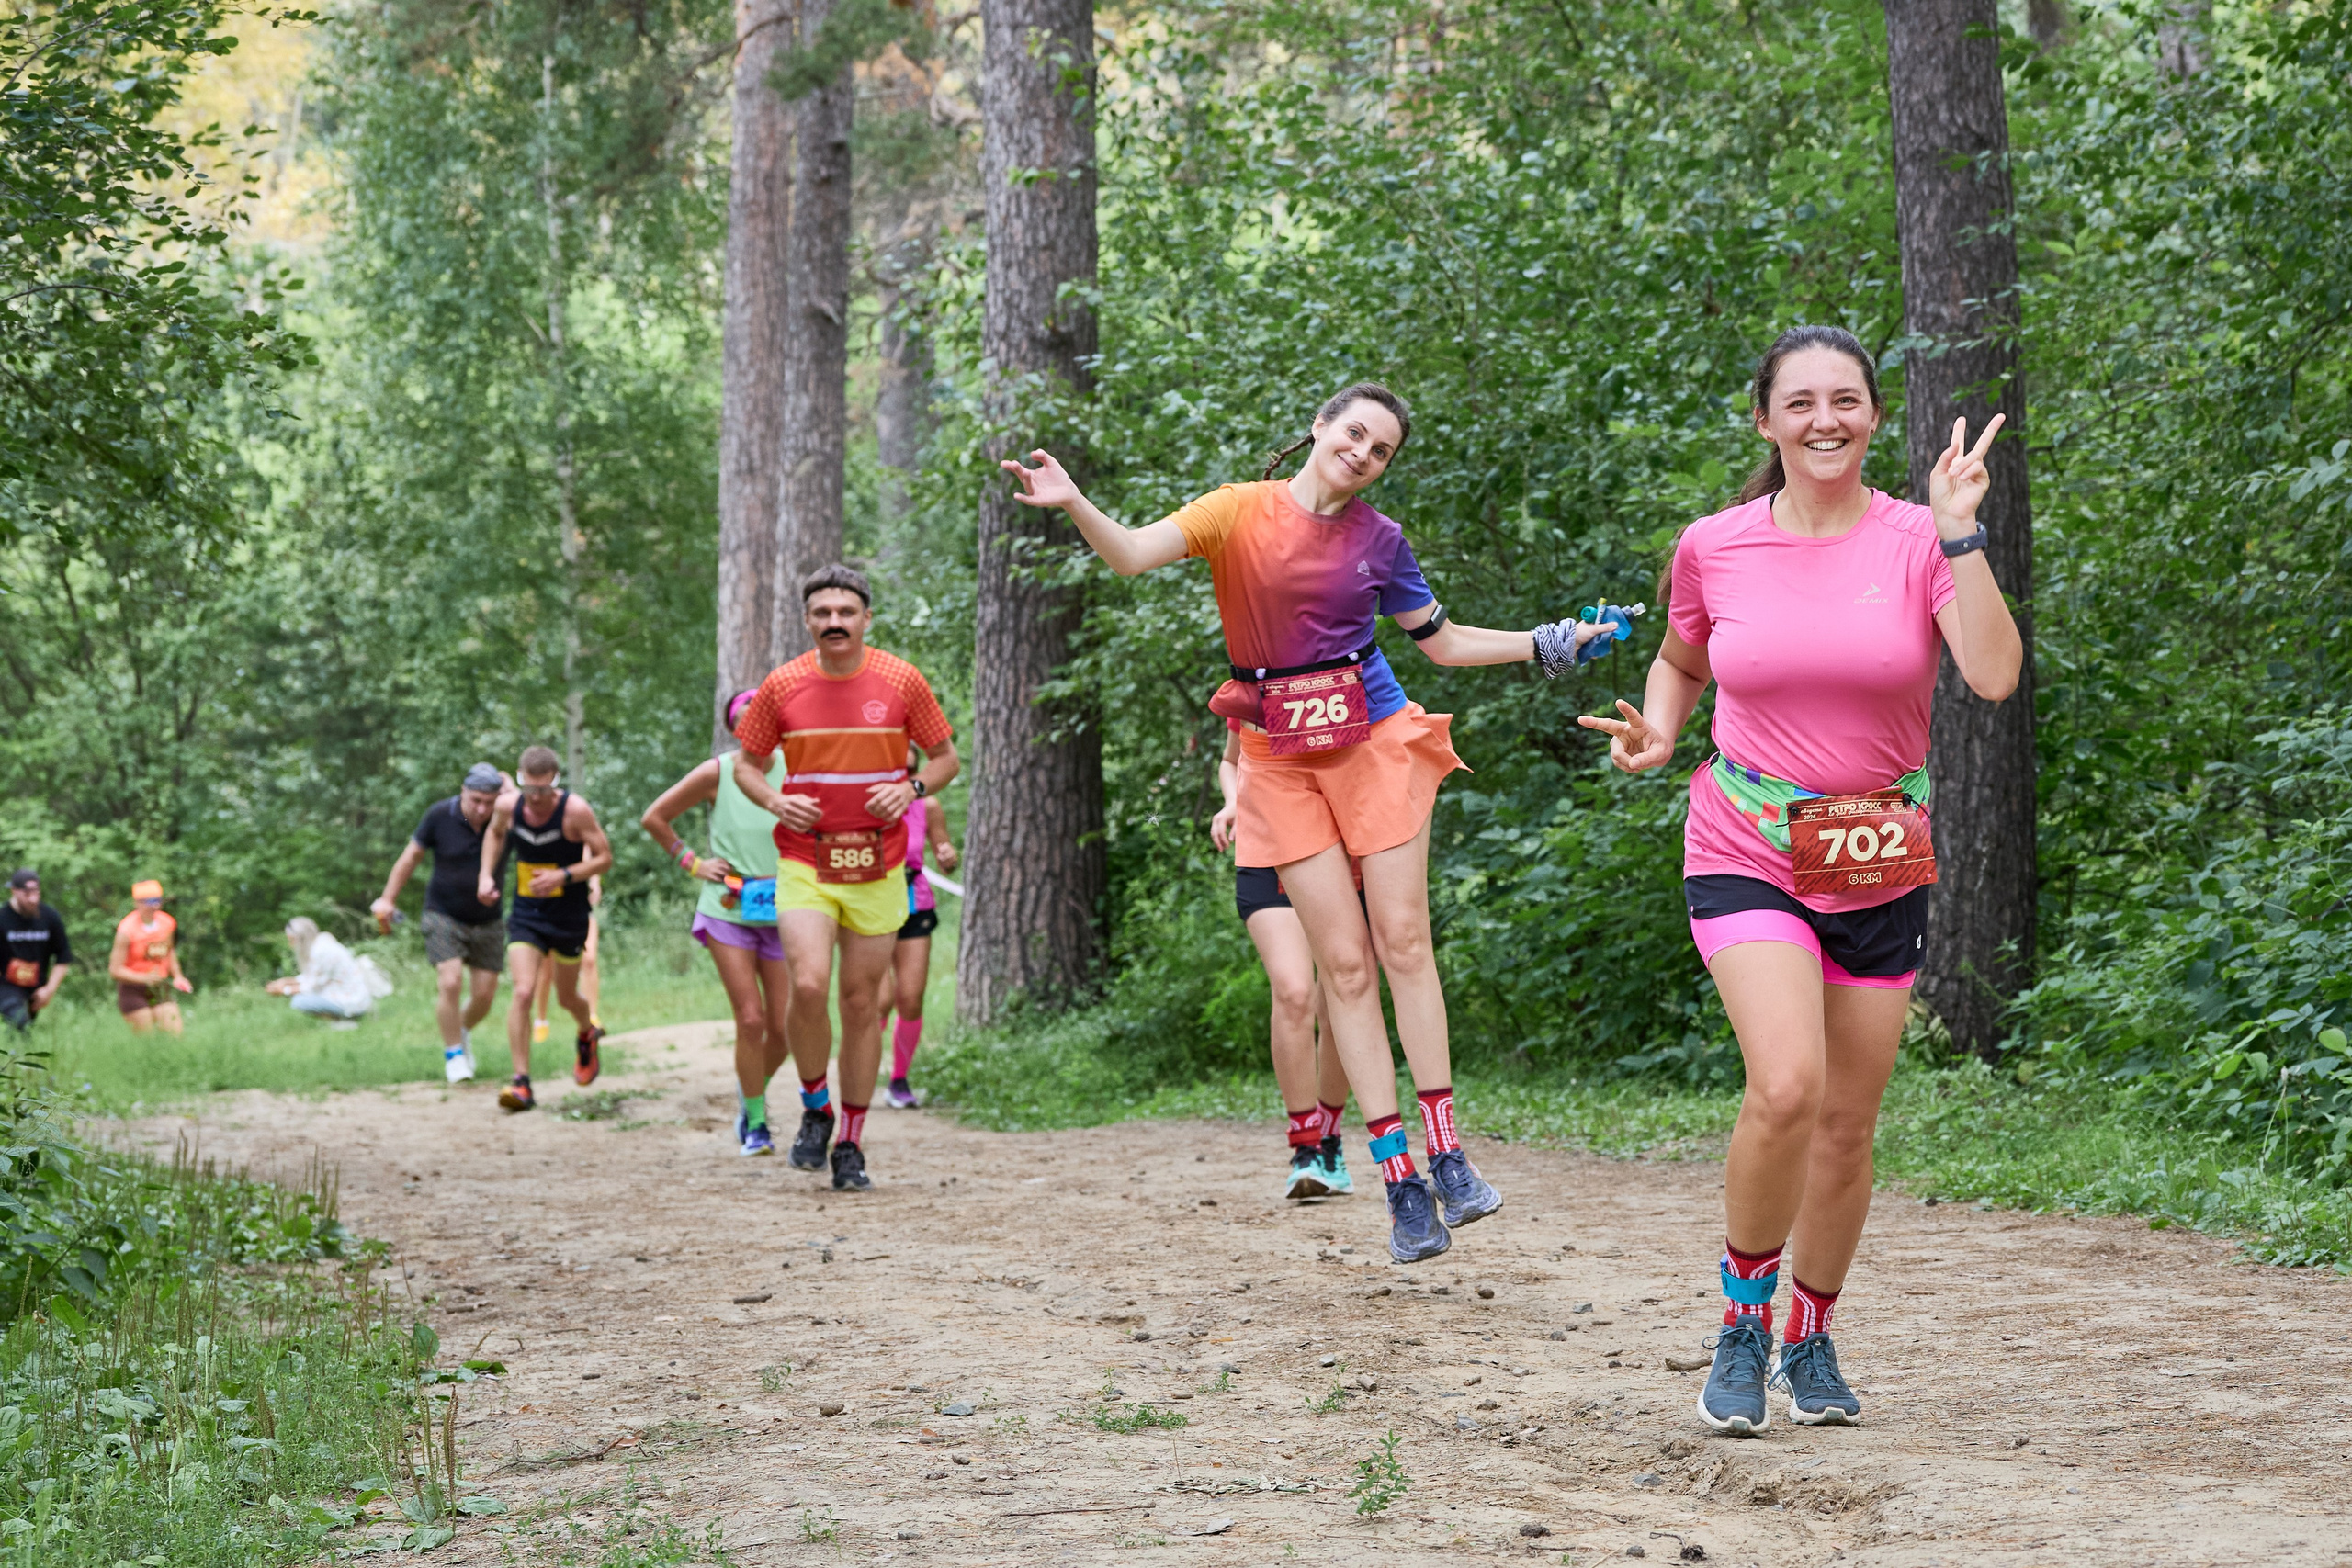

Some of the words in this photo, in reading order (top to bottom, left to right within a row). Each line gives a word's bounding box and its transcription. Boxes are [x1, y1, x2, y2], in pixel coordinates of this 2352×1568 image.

[1283, 694, 1349, 729] 726
[1307, 736, 1316, 746] 6
[1828, 802, 1856, 814] РЕТРО
[1858, 802, 1882, 811] КРОСС
[1818, 821, 1908, 865] 702
[830, 846, 875, 869] 586
[1849, 874, 1858, 884] 6
